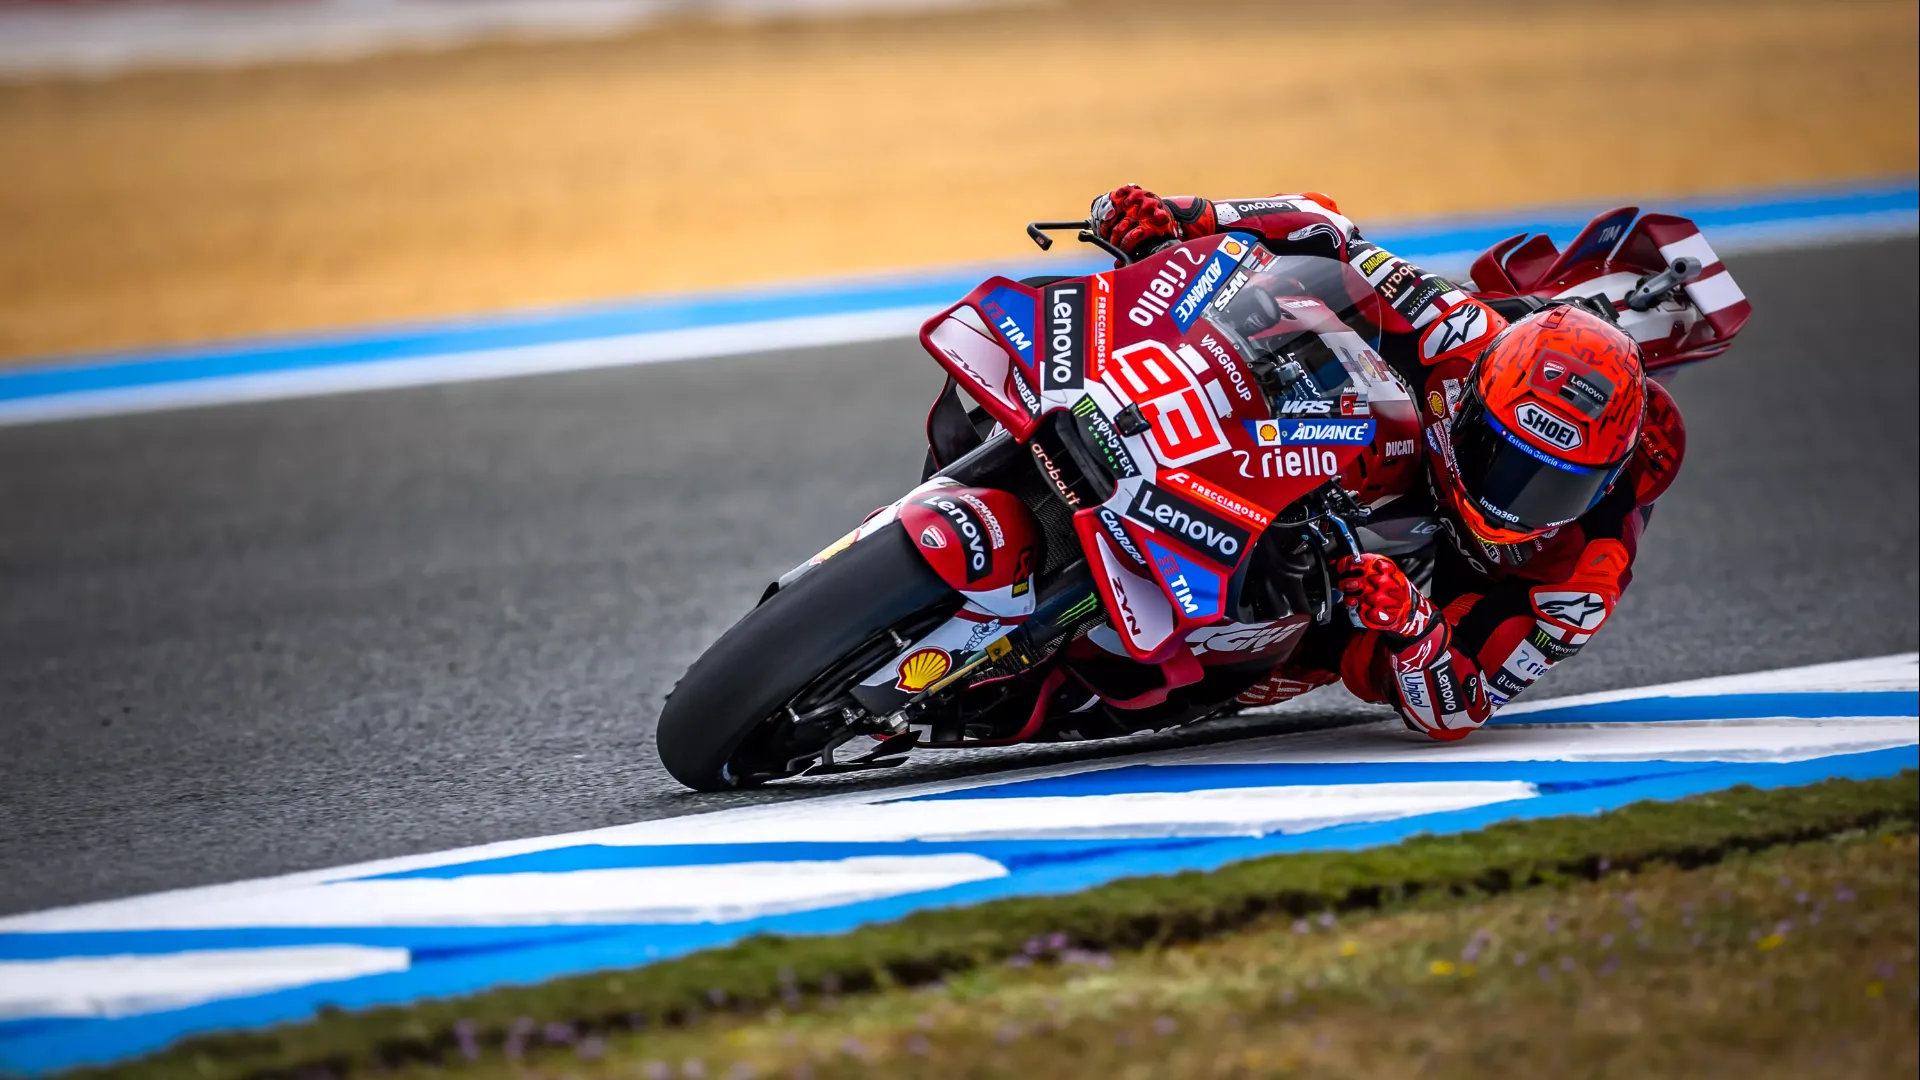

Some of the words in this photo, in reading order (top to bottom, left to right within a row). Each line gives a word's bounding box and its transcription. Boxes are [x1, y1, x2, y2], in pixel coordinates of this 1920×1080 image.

[1238, 202, 1293, 212] Lenovo
[1599, 224, 1622, 244] TIM
[1128, 259, 1188, 328] riello
[1168, 256, 1222, 324] ADVANCE
[1212, 271, 1249, 313] WRS
[999, 316, 1032, 352] TIM
[1051, 288, 1078, 384] Lenovo
[1098, 296, 1106, 372] FRECCIAROSSA
[942, 349, 994, 390] ZYN
[1200, 334, 1252, 402] VARGROUP
[1570, 375, 1604, 402] Lenovo
[1012, 366, 1041, 416] CARRERA
[1102, 342, 1224, 463] 93
[1281, 400, 1334, 414] WRS
[1088, 425, 1119, 469] ENERGY
[1089, 411, 1135, 477] MONSTER
[1290, 425, 1366, 440] ADVANCE
[1385, 439, 1415, 457] DUCATI
[1522, 408, 1576, 447] SHOEI
[1261, 447, 1338, 478] riello
[1507, 434, 1533, 455] Estrella
[1533, 449, 1559, 468] Galicia
[1030, 443, 1081, 507] aruba.it
[1138, 490, 1239, 556] Lenovo
[1190, 481, 1269, 526] FRECCIAROSSA
[1479, 496, 1521, 523] Insta360
[923, 495, 985, 571] Lenovo
[1100, 509, 1147, 566] CARRERA
[1112, 576, 1142, 636] ZYN
[1170, 575, 1199, 614] TIM
[1436, 665, 1457, 711] Lenovo
